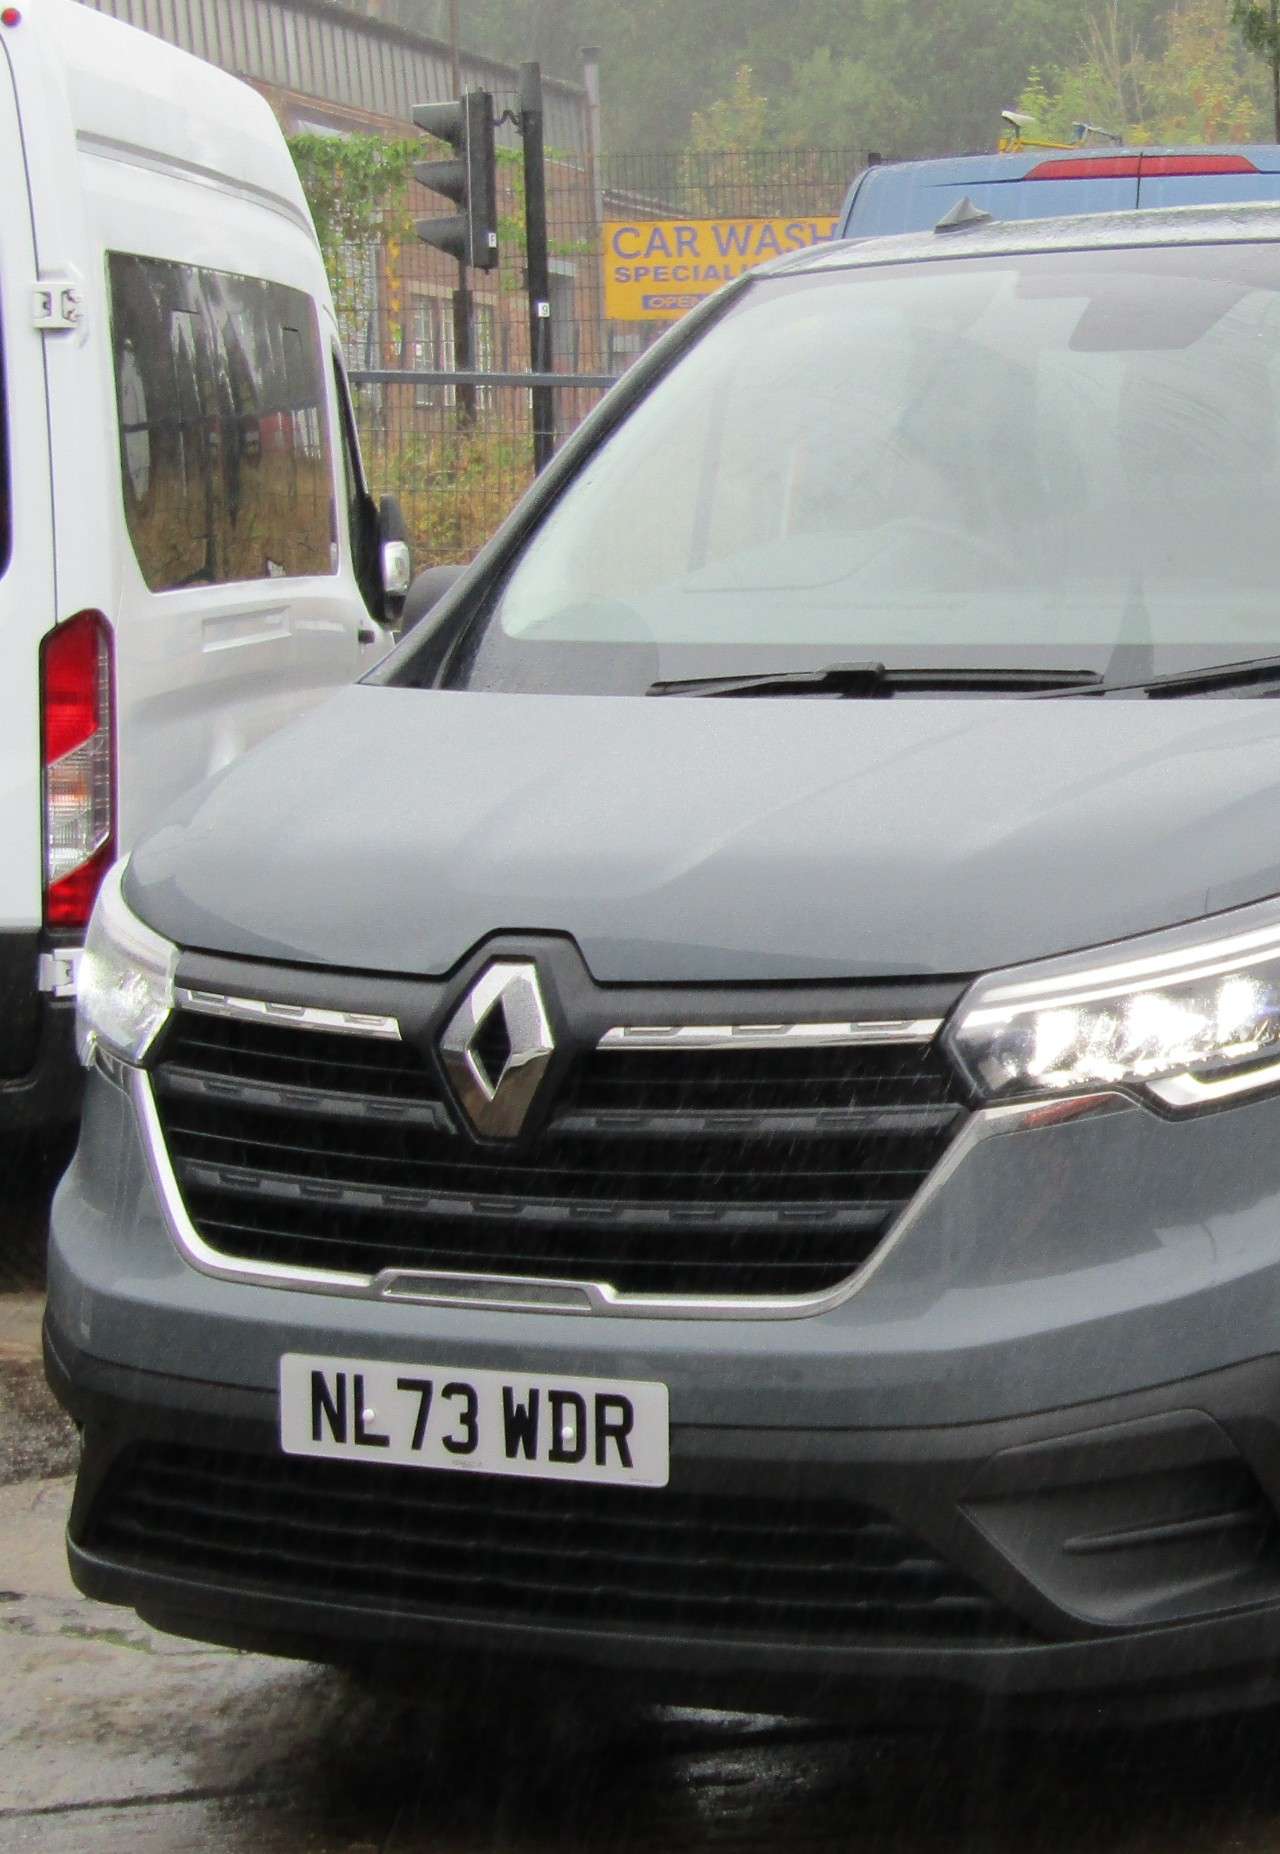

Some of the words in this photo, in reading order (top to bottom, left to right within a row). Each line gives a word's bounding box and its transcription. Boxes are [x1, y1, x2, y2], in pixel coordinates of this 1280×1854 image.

[612, 226, 699, 259] CAR
[711, 223, 838, 256] WASH
[310, 1370, 390, 1447] NL
[396, 1377, 480, 1455] 73
[502, 1386, 635, 1469] WDR
